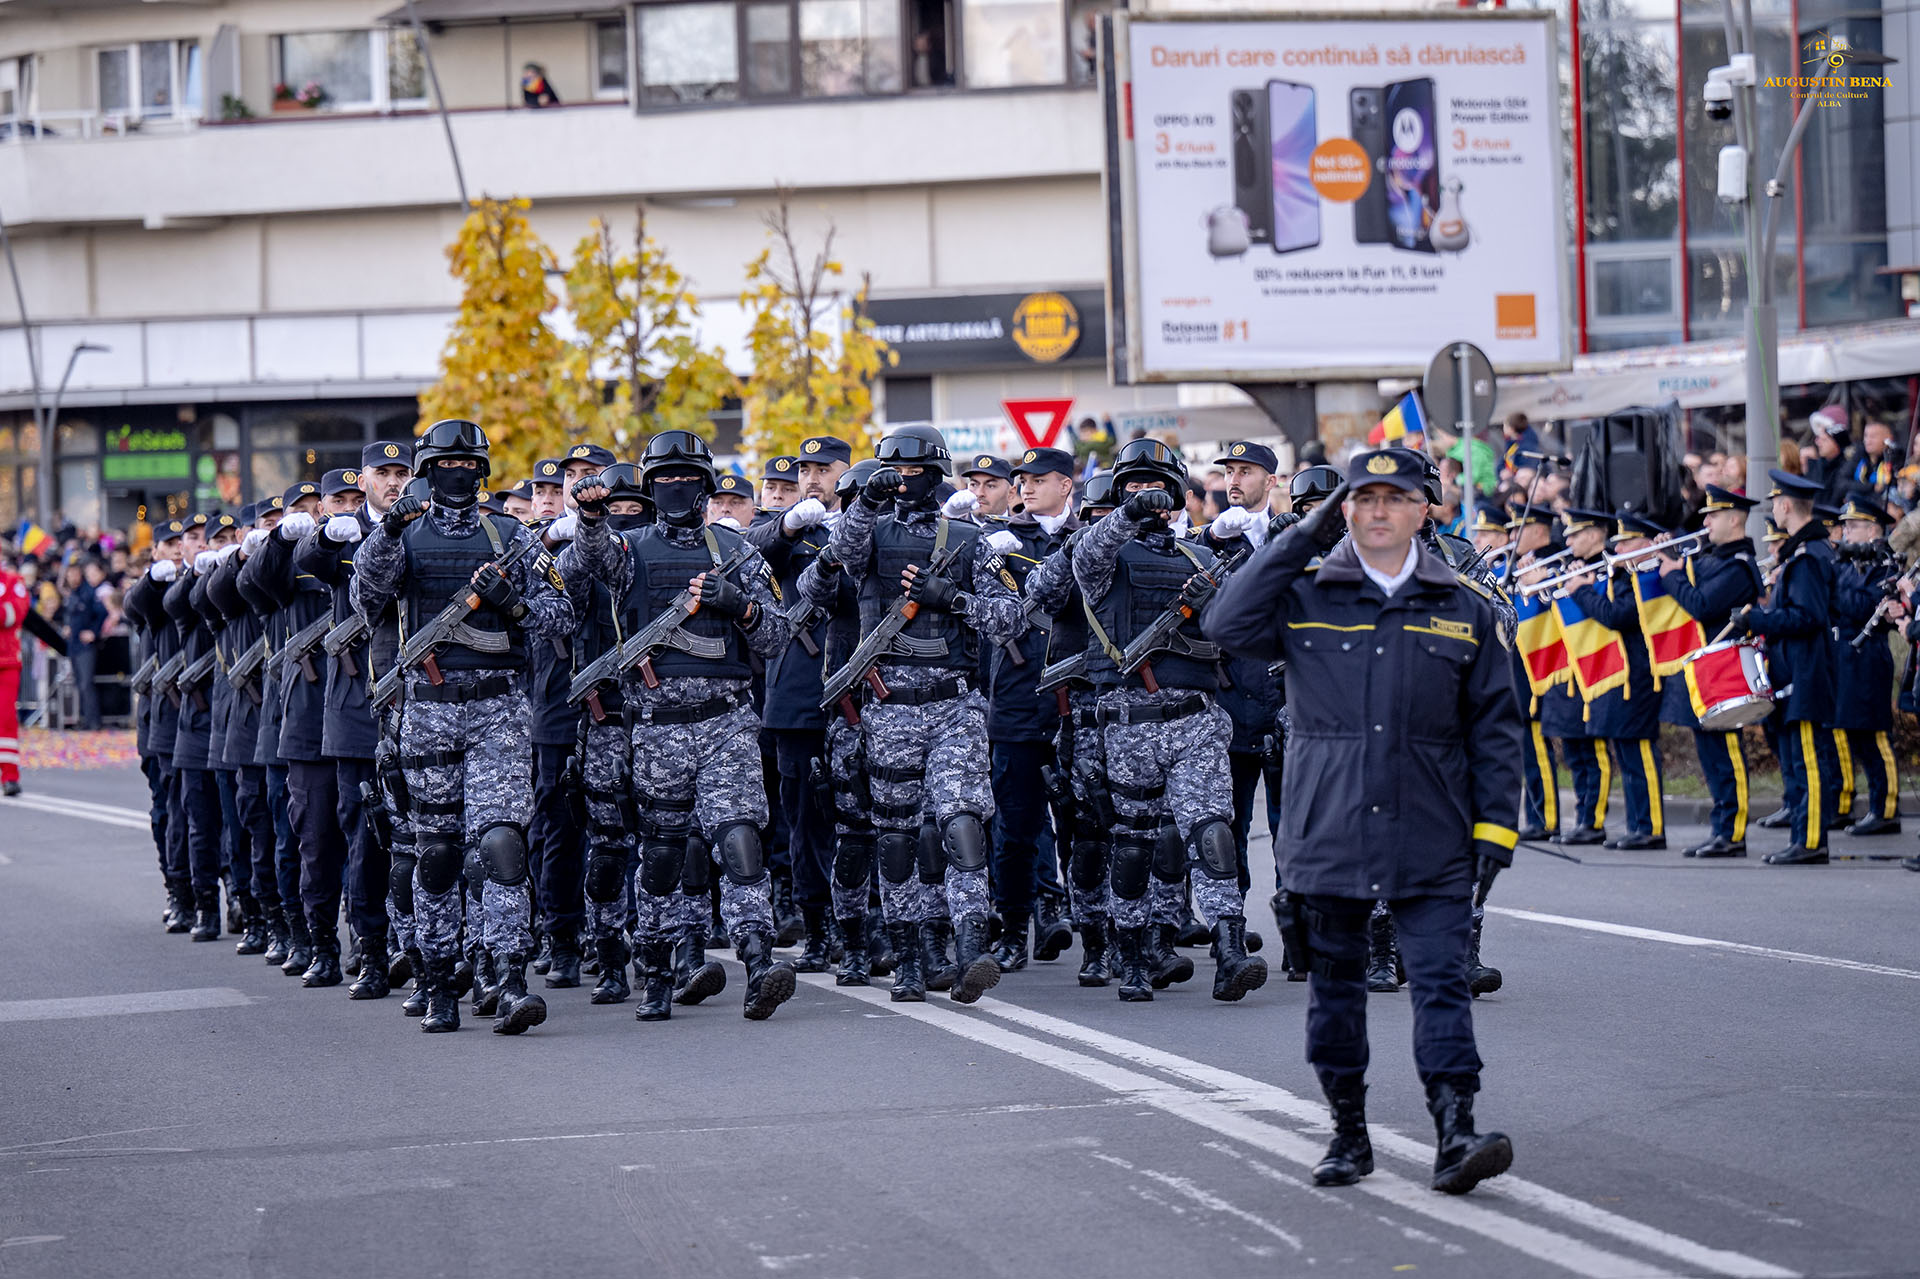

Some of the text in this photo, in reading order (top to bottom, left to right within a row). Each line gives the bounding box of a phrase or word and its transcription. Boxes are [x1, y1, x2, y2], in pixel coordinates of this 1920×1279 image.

[1151, 44, 1526, 68] Daruri care continuă să dăruiască
[1450, 98, 1501, 109] Motorola
[1489, 112, 1529, 123] Edition
[1155, 132, 1170, 154] 3
[1452, 129, 1466, 151] 3
[1313, 170, 1365, 182] nelimitat
[1286, 267, 1343, 280] reducere
[532, 552, 550, 573] 776
[986, 555, 1003, 573] 791
